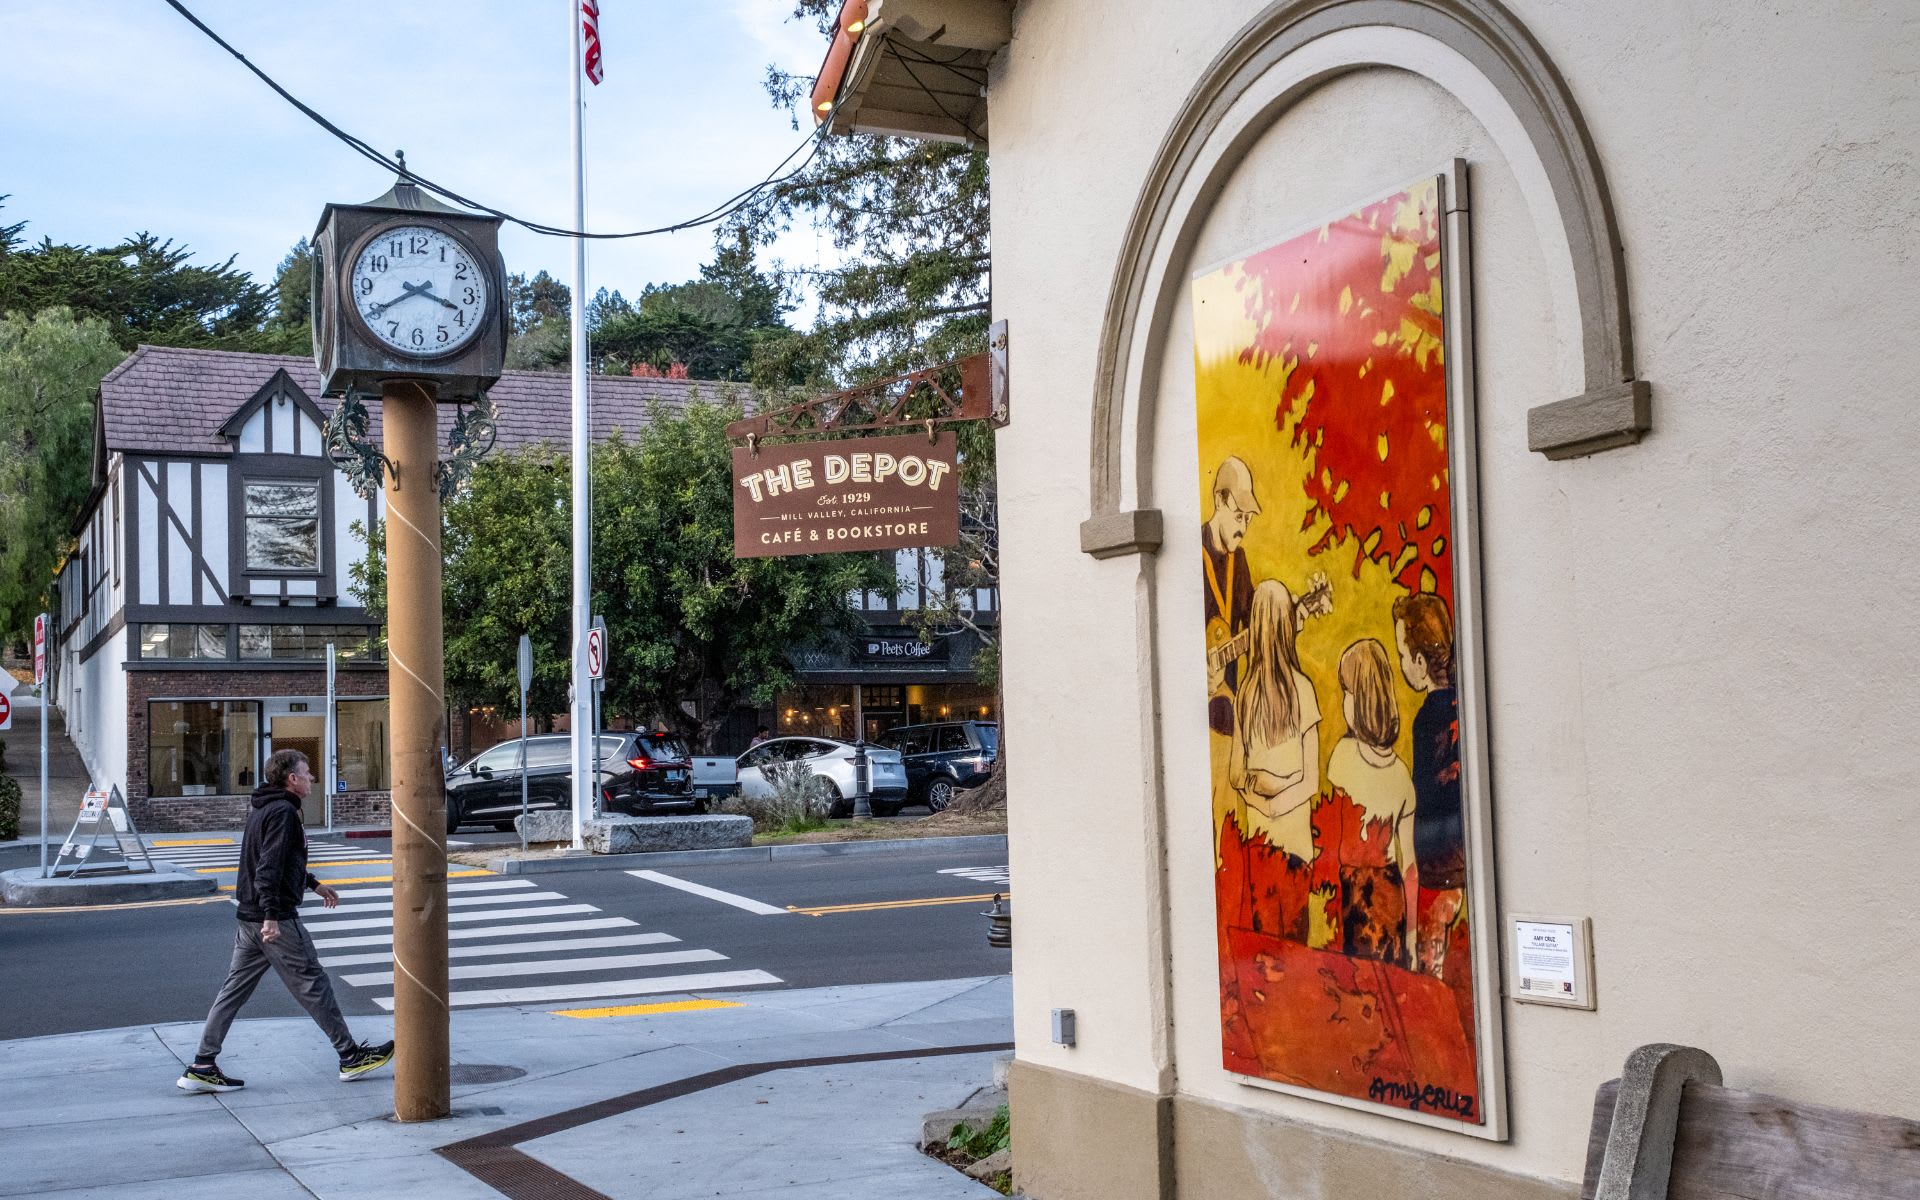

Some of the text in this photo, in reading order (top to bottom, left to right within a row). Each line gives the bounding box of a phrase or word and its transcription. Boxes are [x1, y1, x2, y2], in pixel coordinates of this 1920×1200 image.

[389, 240, 404, 258] 11
[409, 236, 429, 254] 12
[440, 245, 446, 262] 1
[370, 254, 388, 273] 10
[454, 262, 468, 280] 2
[361, 277, 373, 296] 9
[463, 286, 475, 305] 3
[369, 301, 382, 320] 8
[453, 309, 466, 327] 4
[387, 320, 399, 338] 7
[411, 328, 424, 346] 6
[436, 325, 449, 342] 5
[740, 452, 951, 503] THE DEPOT
[842, 492, 871, 504] 1929
[781, 505, 911, 521] MILL VALLEY, CALIFORNIA
[761, 522, 928, 544] CAFÉ & BOOKSTORE
[880, 641, 930, 656] Peet's Coffee
